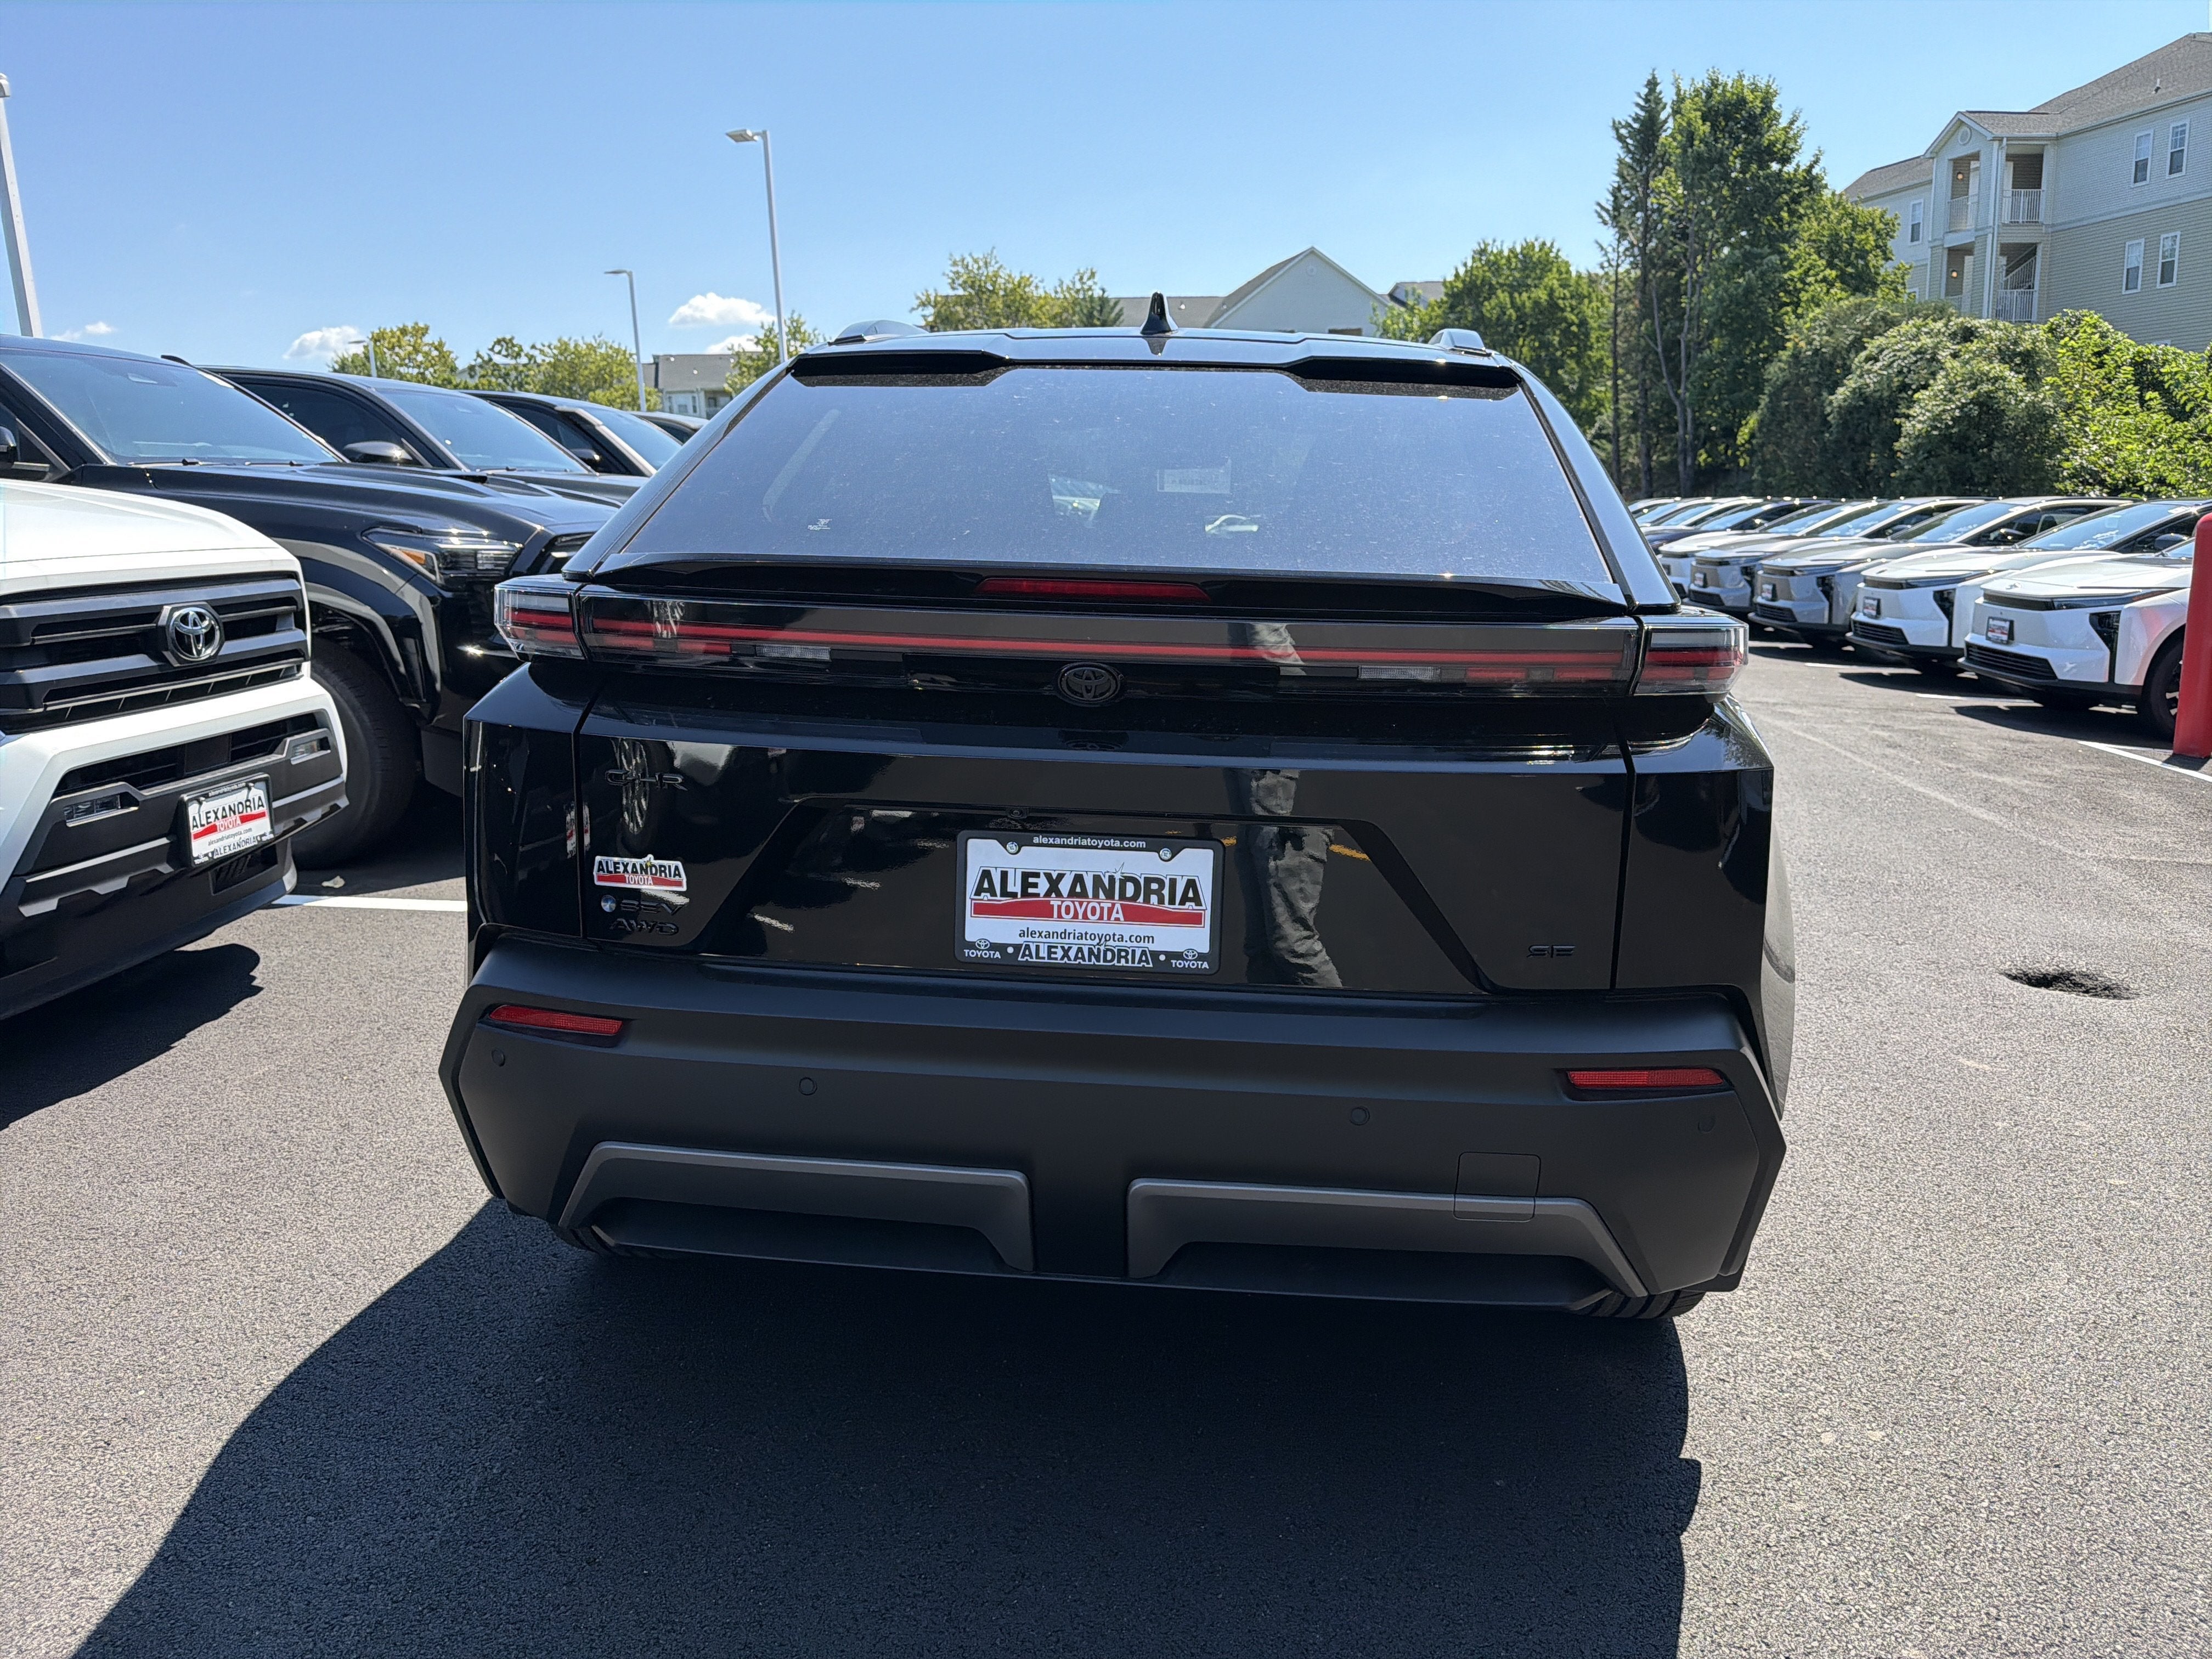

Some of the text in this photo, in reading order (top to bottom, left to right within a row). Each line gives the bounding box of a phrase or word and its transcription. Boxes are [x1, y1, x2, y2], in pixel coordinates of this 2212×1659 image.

[192, 795, 264, 830] ALEXANDRIA
[216, 816, 241, 832] TOYOTA
[214, 836, 257, 857] ALEXANDRIA
[1032, 834, 1147, 849] alexandriatoyota.com
[596, 860, 682, 878] ALEXANDRIA
[624, 874, 653, 885] TOYOTA
[973, 868, 1203, 907] ALEXANDRIA
[620, 900, 685, 915] BEV
[1050, 901, 1124, 921] TOYOTA
[609, 918, 679, 935] AWD
[1019, 927, 1154, 945] alexandriatoyota.com
[964, 944, 1209, 969] TOYOTA ALEXANDRIA TOYOTA
[1527, 944, 1576, 958] SE
